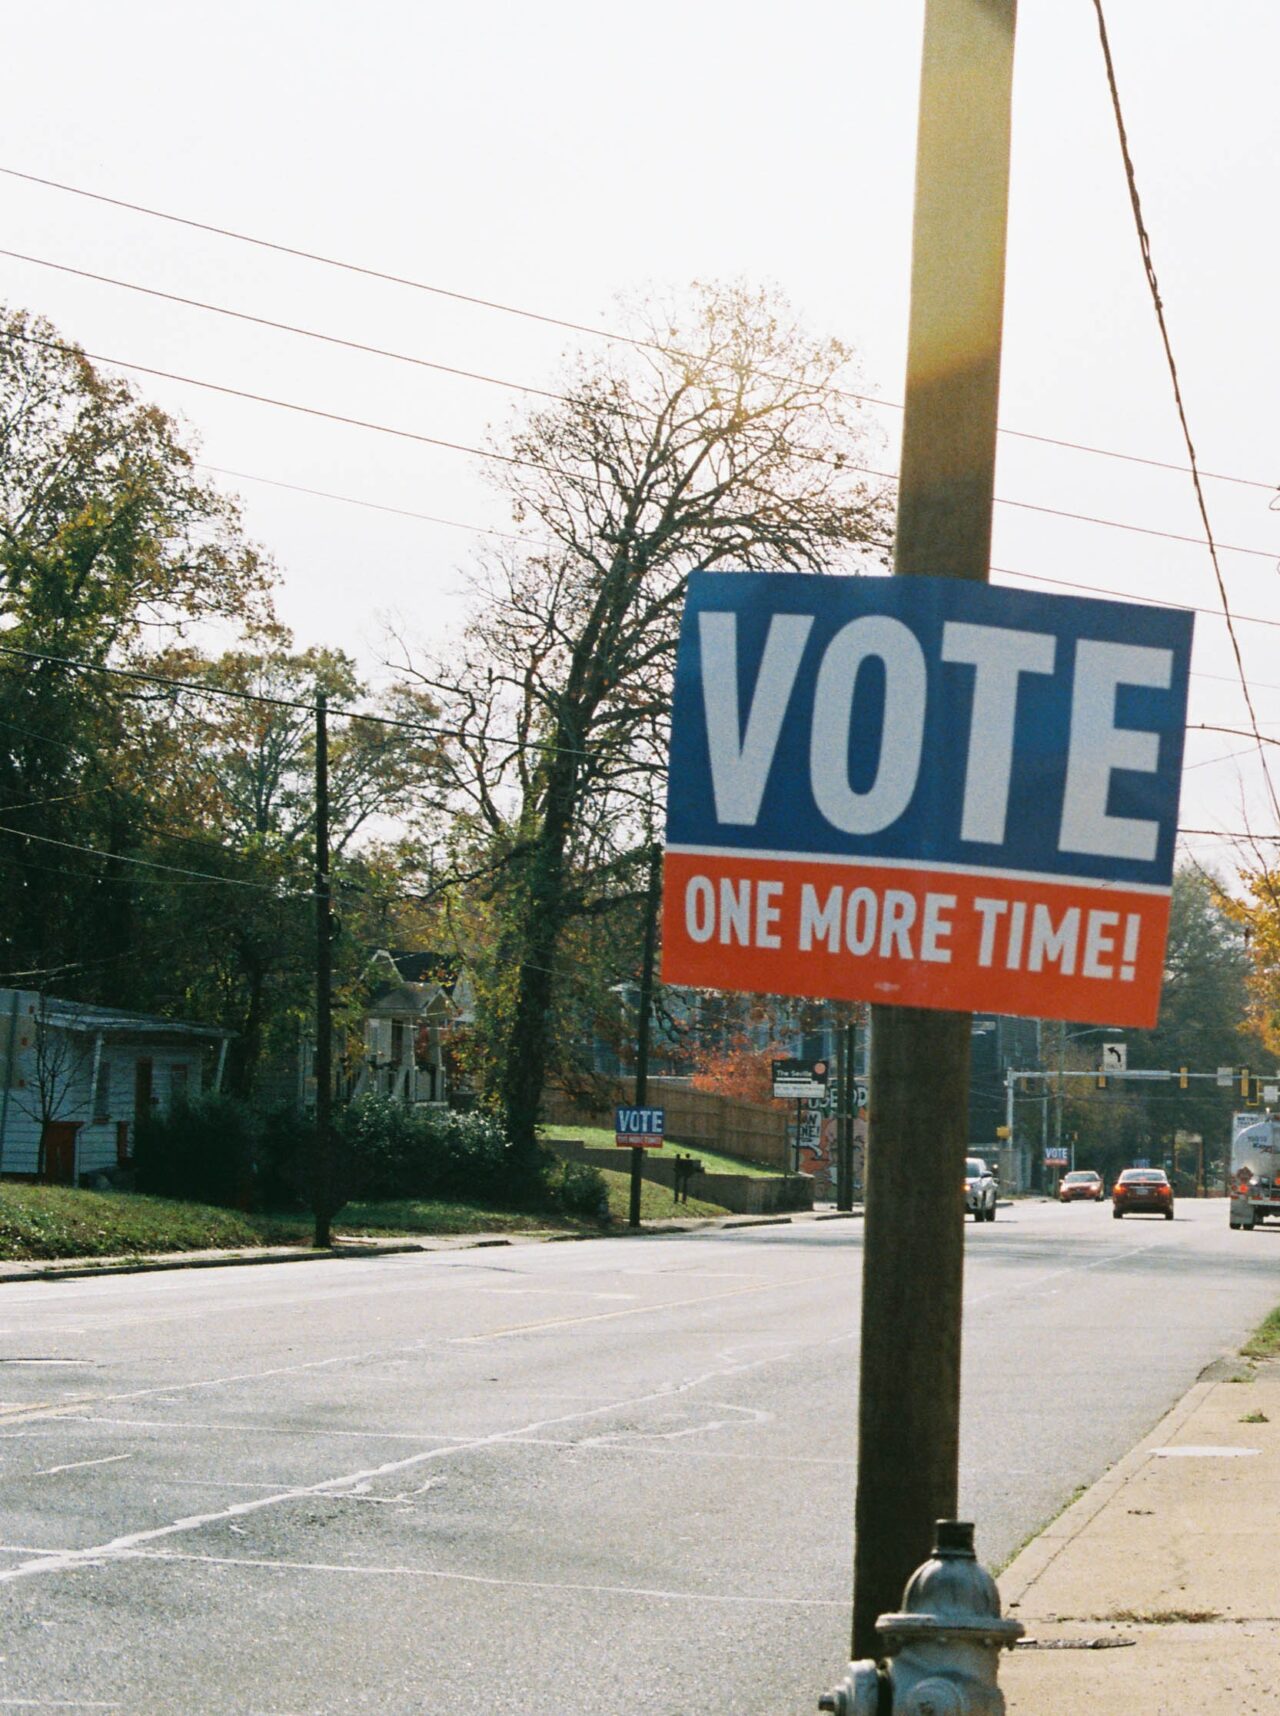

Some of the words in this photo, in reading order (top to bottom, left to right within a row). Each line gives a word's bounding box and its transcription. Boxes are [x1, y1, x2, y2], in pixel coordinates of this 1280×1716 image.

[698, 611, 1174, 862] VOTE
[684, 874, 782, 949] ONE
[798, 883, 958, 964] MORE
[974, 897, 1142, 982] TIME!
[618, 1110, 663, 1132] VOTE
[1045, 1147, 1068, 1159] VOTE
